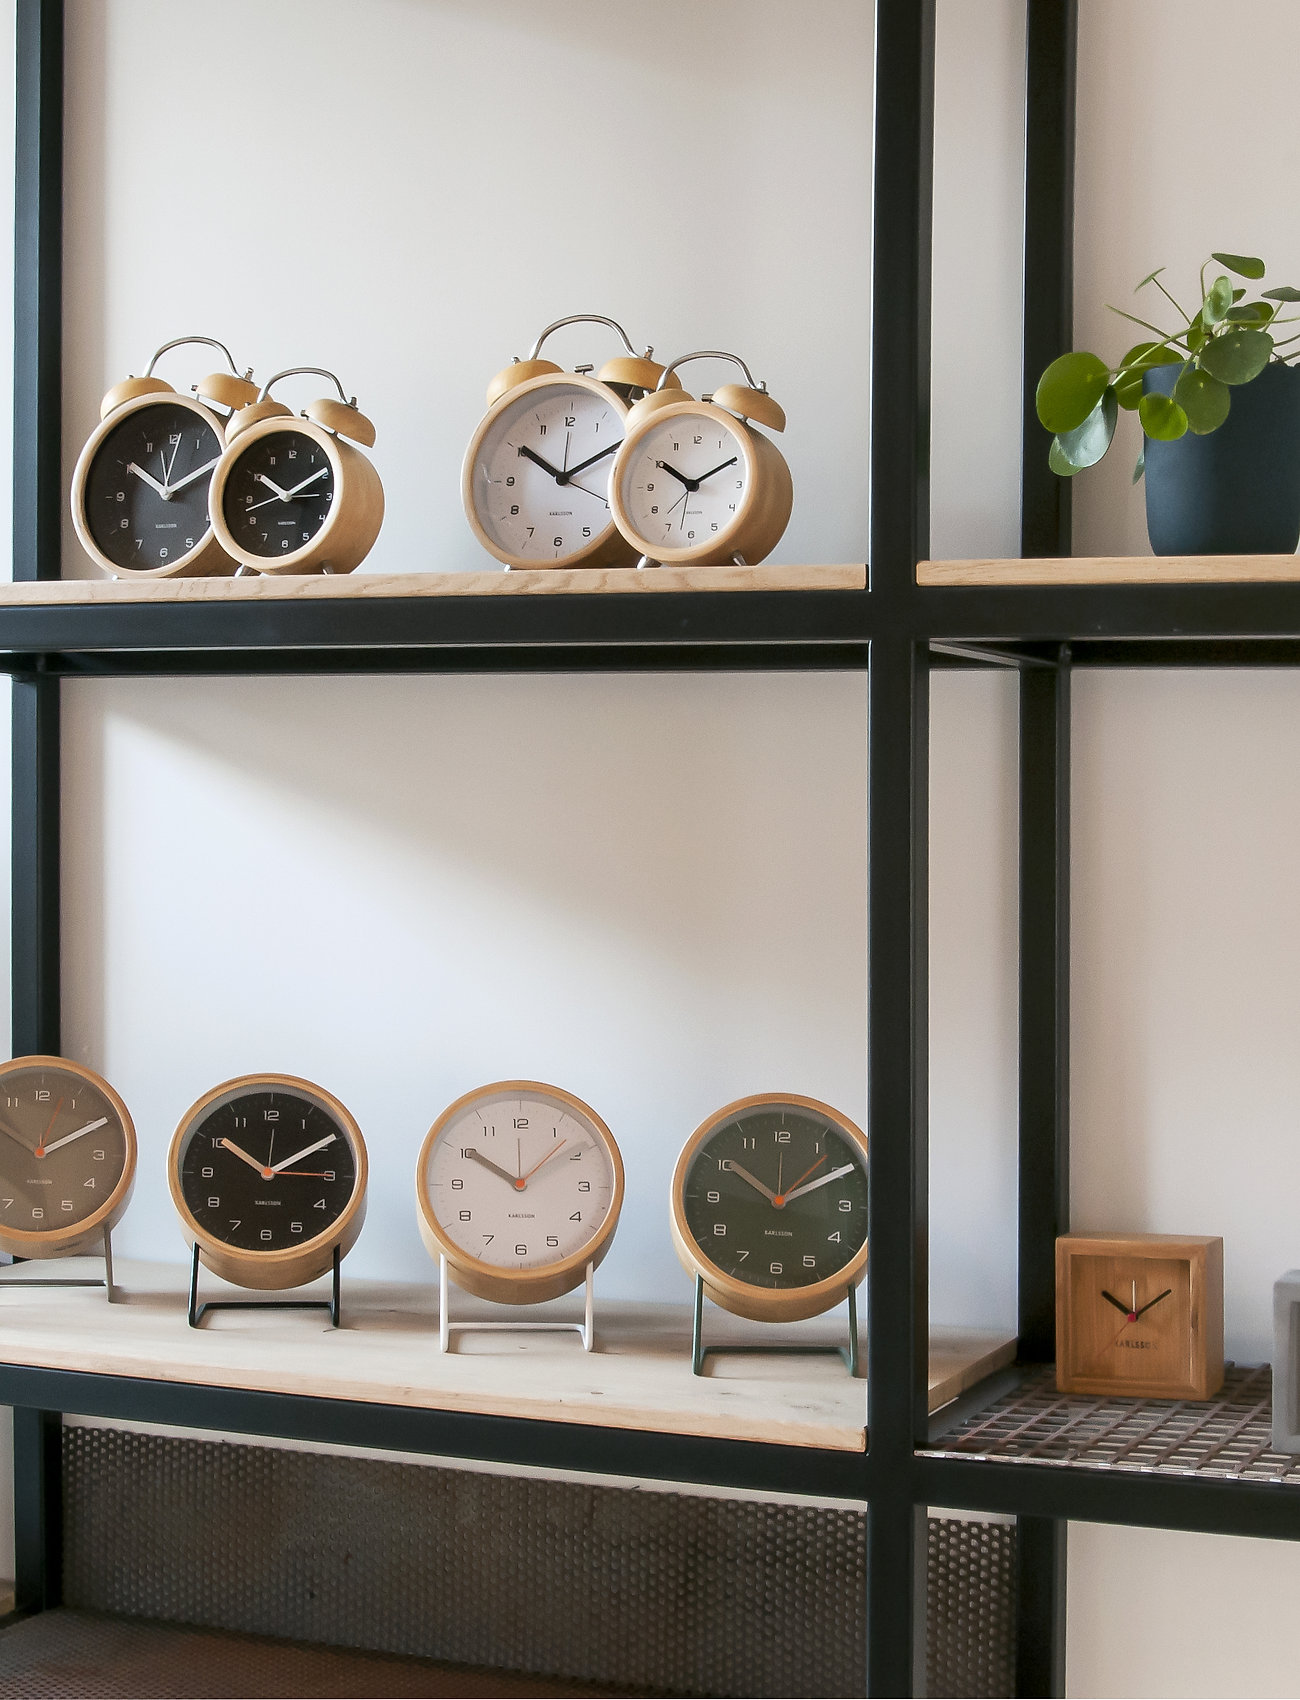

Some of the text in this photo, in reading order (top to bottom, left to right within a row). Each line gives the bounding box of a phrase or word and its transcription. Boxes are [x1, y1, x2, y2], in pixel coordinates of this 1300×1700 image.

[565, 417, 576, 426] 12
[540, 425, 546, 435] 11
[596, 423, 599, 432] 1
[196, 439, 199, 449] 1
[694, 436, 702, 444] 12
[146, 443, 152, 452] 11
[288, 450, 297, 459] 12
[506, 477, 515, 486] 9
[736, 481, 742, 489] 3
[647, 483, 654, 491] 9
[116, 492, 125, 501] 9
[326, 493, 332, 501] 3
[511, 505, 519, 515] 8
[652, 506, 658, 514] 8
[120, 519, 129, 528] 8
[665, 524, 672, 532] 7
[711, 523, 718, 531] 5
[262, 533, 268, 541] 7
[303, 532, 310, 540] 5
[526, 527, 534, 537] 7
[582, 527, 591, 537] 5
[136, 539, 143, 549] 7
[185, 538, 194, 548] 5
[282, 540, 288, 548] 6
[554, 537, 562, 546] 6
[160, 548, 168, 557] 6
[35, 1090, 50, 1100] 12
[7, 1097, 18, 1108] 11
[72, 1100, 76, 1109] 1
[264, 1110, 280, 1121] 12
[235, 1117, 247, 1128] 11
[302, 1119, 306, 1130] 1
[513, 1118, 529, 1129] 12
[483, 1126, 495, 1137] 11
[552, 1128, 557, 1138] 1
[774, 1131, 791, 1143] 12
[212, 1138, 227, 1148] 10
[743, 1138, 755, 1150] 11
[815, 1142, 819, 1154] 1
[93, 1150, 104, 1161] 3
[460, 1148, 477, 1159] 10
[718, 1159, 734, 1171] 10
[202, 1167, 213, 1178] 9
[324, 1171, 335, 1181] 3
[84, 1177, 95, 1188] 4
[452, 1179, 464, 1190] 9
[578, 1181, 591, 1192] 3
[208, 1196, 219, 1207] 8
[707, 1191, 720, 1203] 9
[3, 1199, 14, 1209] 7
[61, 1200, 73, 1211] 5
[313, 1199, 326, 1210] 4
[838, 1200, 852, 1212] 3
[32, 1208, 43, 1218] 6
[459, 1210, 471, 1221] 8
[569, 1211, 582, 1222] 4
[229, 1220, 242, 1231] 7
[291, 1222, 303, 1233] 5
[714, 1224, 726, 1236] 8
[260, 1230, 272, 1240] 6
[482, 1234, 494, 1246] 7
[827, 1231, 842, 1243] 4
[546, 1236, 559, 1247] 5
[515, 1244, 527, 1255] 6
[737, 1251, 750, 1262] 7
[803, 1255, 816, 1267] 5
[770, 1262, 783, 1274] 6
